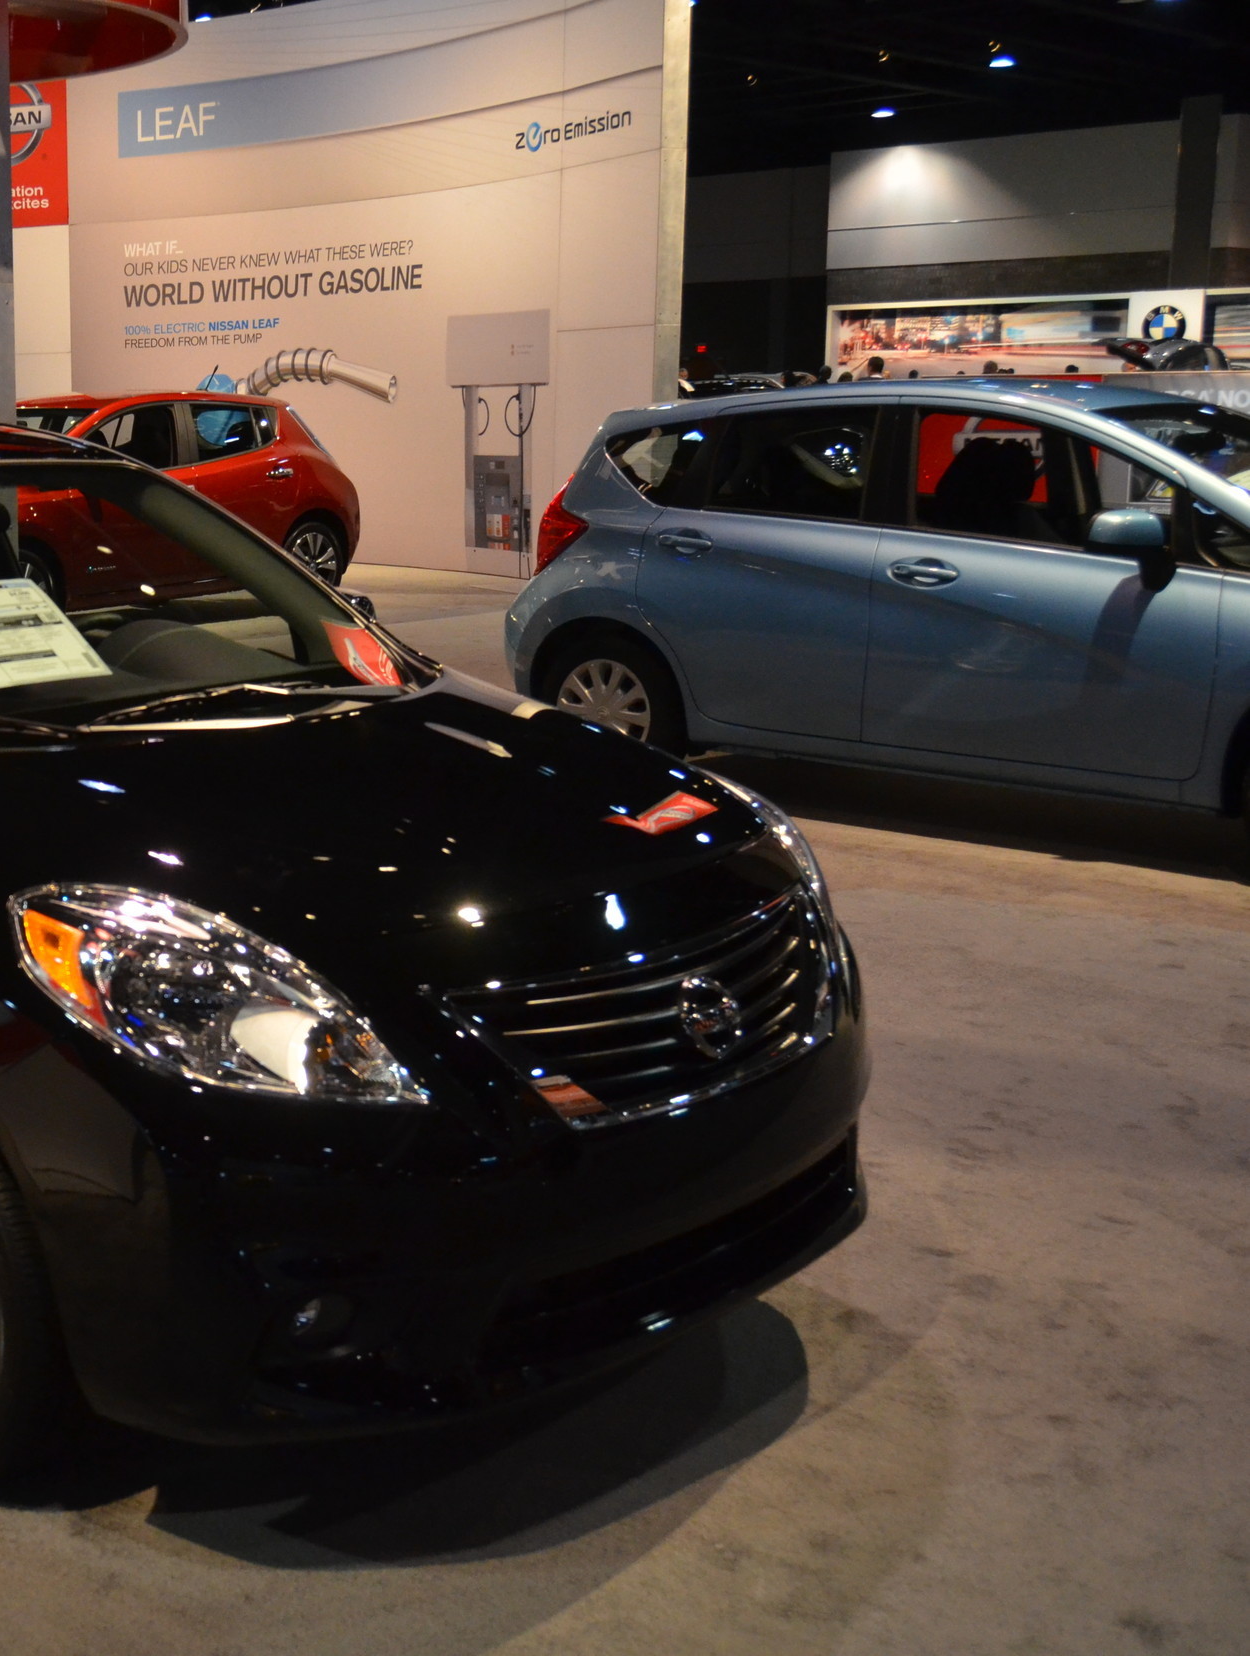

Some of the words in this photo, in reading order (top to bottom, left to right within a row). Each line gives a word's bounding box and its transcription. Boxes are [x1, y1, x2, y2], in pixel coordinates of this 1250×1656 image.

[10, 110, 42, 126] AN
[137, 101, 217, 143] LEAF
[515, 121, 561, 152] zero
[564, 110, 632, 141] Emission
[11, 197, 50, 210] cites
[124, 241, 163, 258] WHAT
[124, 261, 154, 277] OUR
[157, 259, 188, 275] KIDS
[192, 255, 236, 273] NEVER
[239, 251, 281, 269] KNEW
[284, 248, 323, 265] WHAT
[325, 244, 366, 261] THESE
[369, 239, 414, 258] WERE?
[123, 281, 205, 308] WORLD
[211, 272, 313, 303] WITHOUT
[318, 264, 423, 296] GASOLINE
[124, 325, 151, 336] 100%
[154, 322, 206, 335] ELECTRIC
[208, 320, 249, 332] NISSAN
[252, 318, 280, 330] LEAF
[124, 337, 175, 349] FREEDOM
[178, 335, 208, 347] FROM
[211, 334, 231, 345] THE
[233, 332, 263, 345] PUMP
